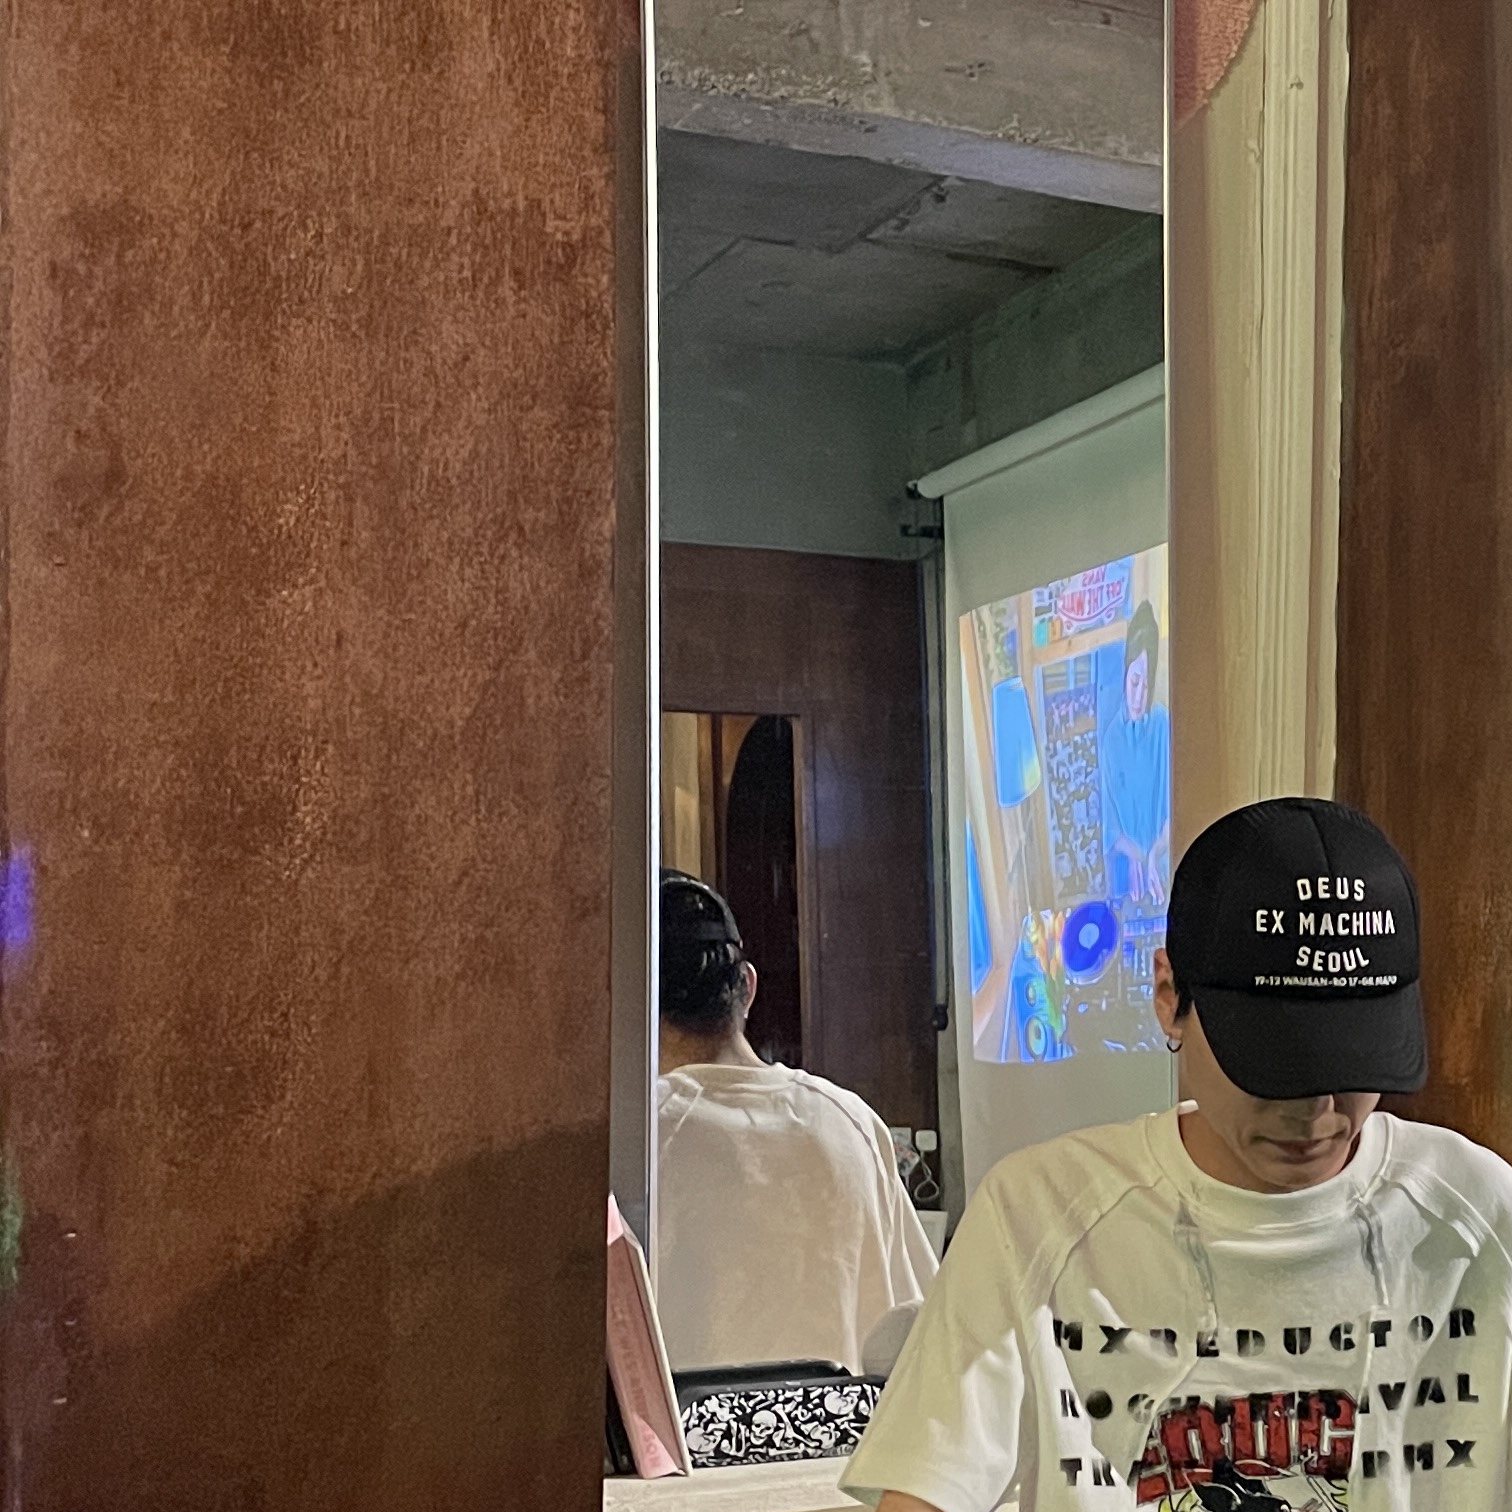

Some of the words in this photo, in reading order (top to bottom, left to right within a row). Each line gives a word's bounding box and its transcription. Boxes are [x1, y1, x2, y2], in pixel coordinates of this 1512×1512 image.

[1296, 876, 1365, 901] DEUS
[1256, 909, 1285, 934] EX
[1299, 909, 1396, 936] MACHINA
[1296, 945, 1370, 973] SEOUL
